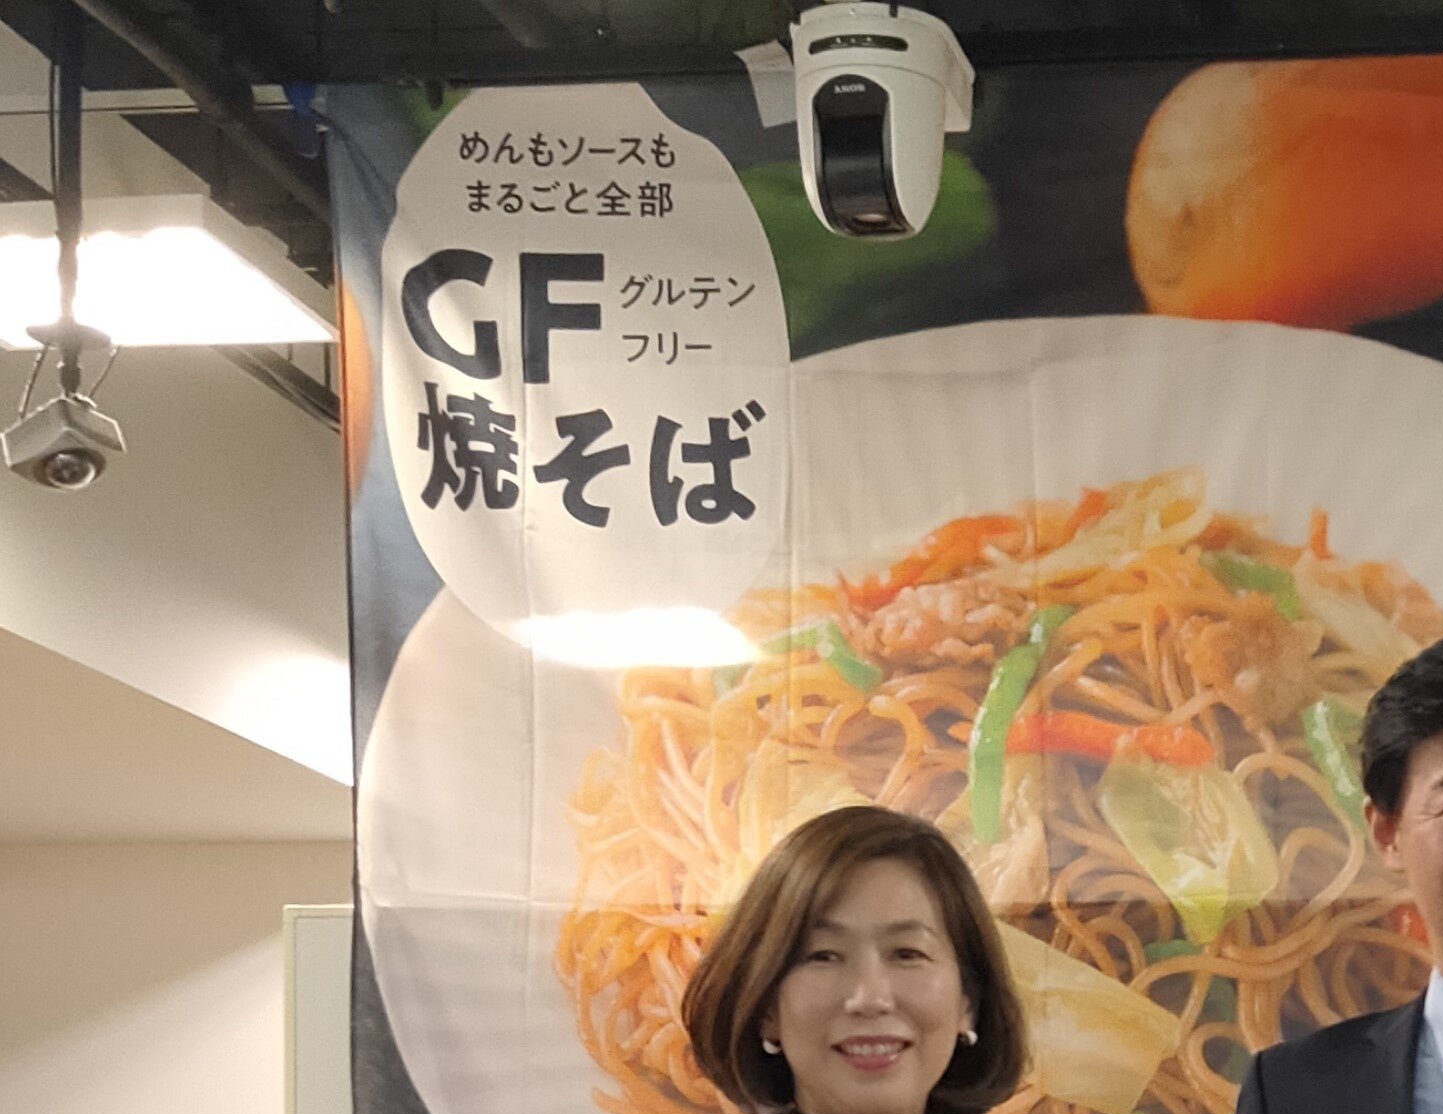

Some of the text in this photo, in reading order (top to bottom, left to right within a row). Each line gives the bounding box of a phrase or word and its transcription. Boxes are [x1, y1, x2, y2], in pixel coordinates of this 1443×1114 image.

[458, 131, 677, 168] めんもソースも
[465, 181, 674, 217] まるごと全部
[619, 273, 757, 310] グルテン
[401, 247, 605, 384] GF
[621, 332, 714, 365] フリー
[416, 381, 767, 528] 焼そば
